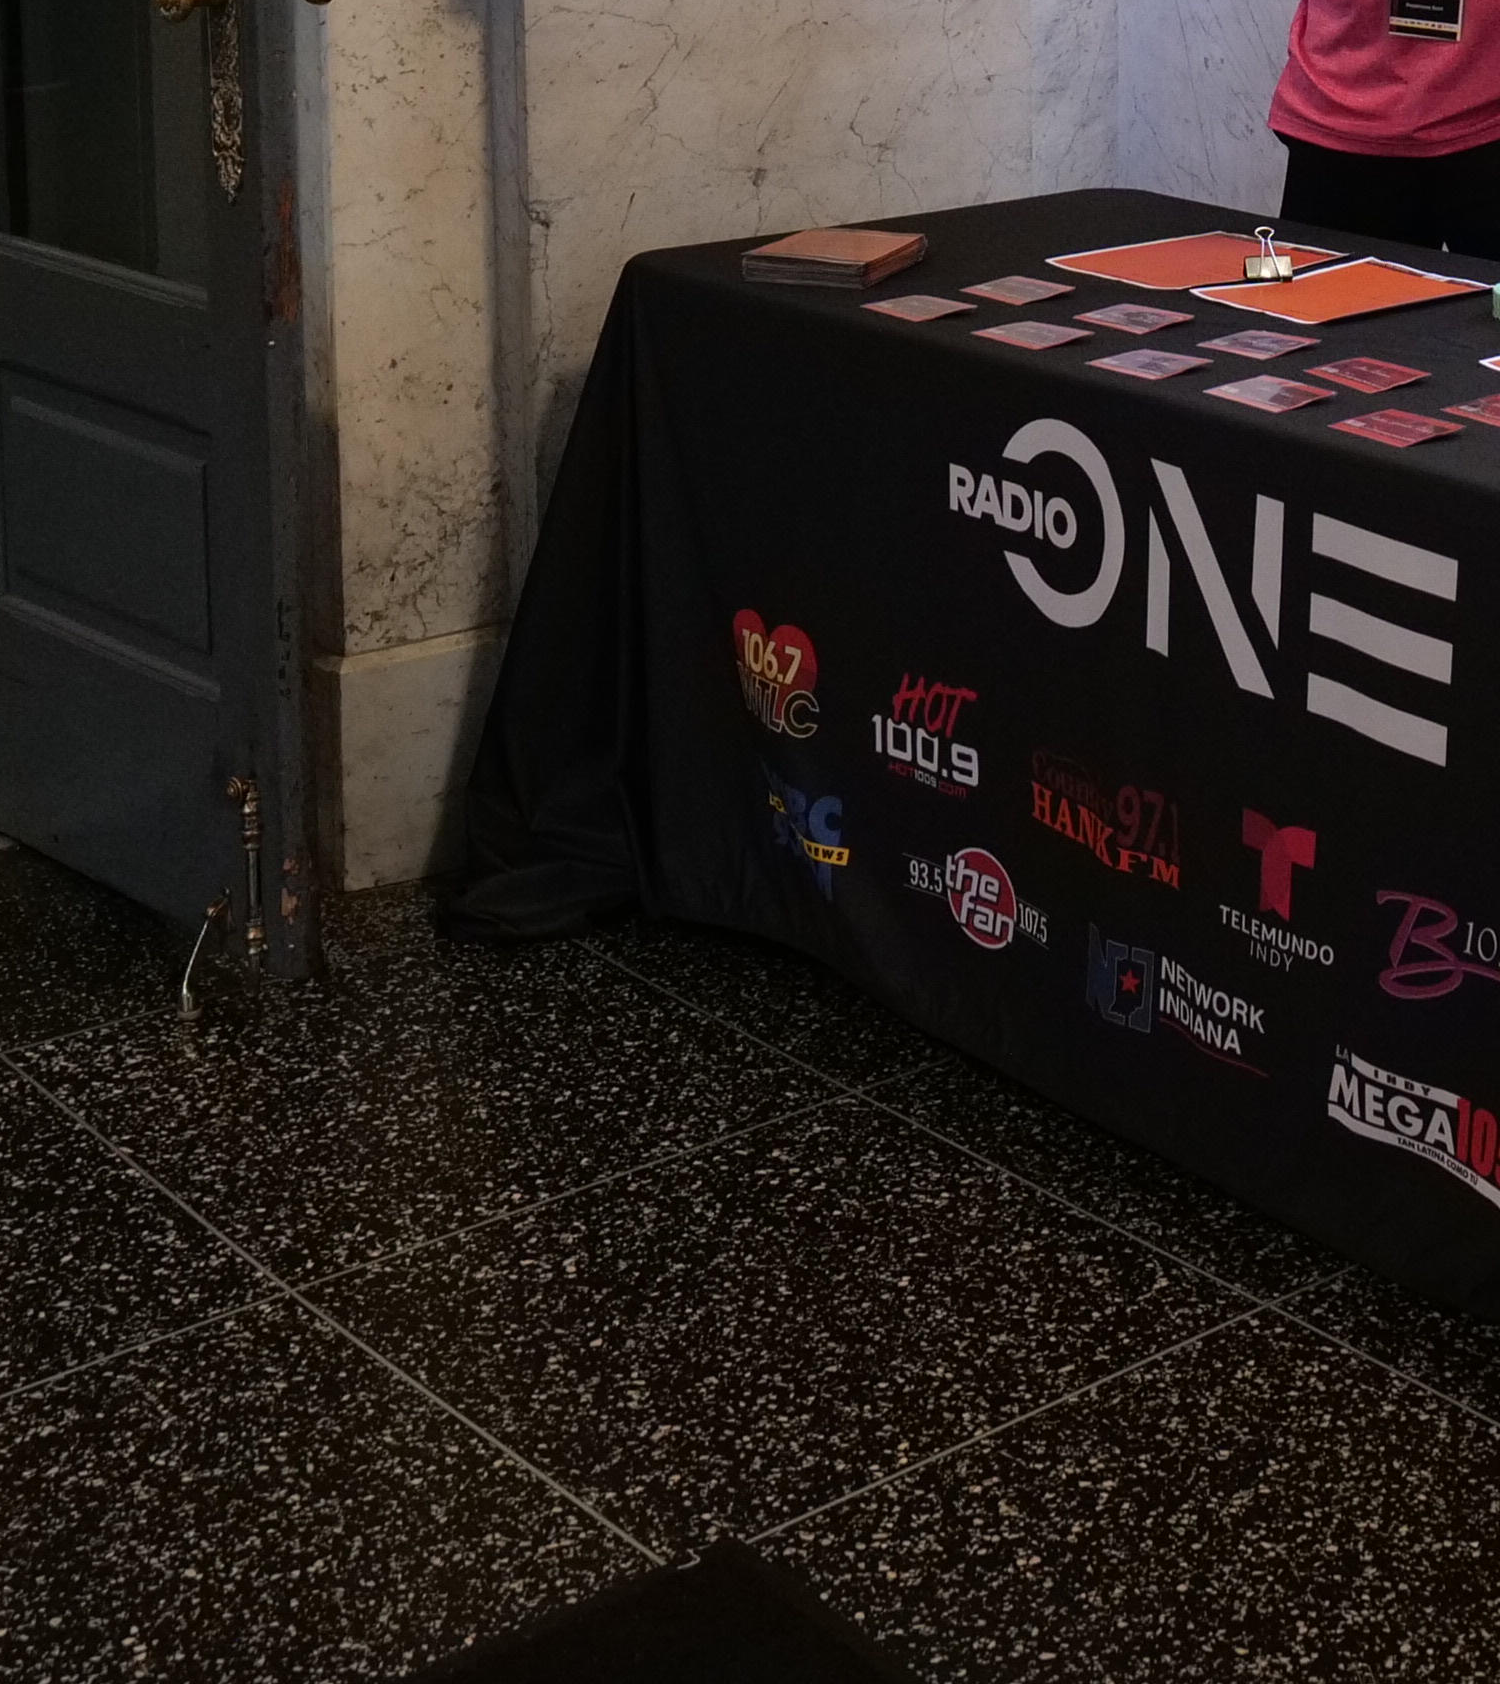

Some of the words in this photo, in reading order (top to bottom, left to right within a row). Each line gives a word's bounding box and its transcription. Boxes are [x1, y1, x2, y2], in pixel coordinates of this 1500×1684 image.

[949, 462, 1078, 550] RADIO
[1001, 417, 1458, 767] ONE
[742, 628, 802, 685] 106.7
[736, 661, 820, 738] WTLC
[893, 673, 979, 738] HOT
[871, 714, 980, 787] 100.9
[1031, 780, 1114, 867] HANK
[1116, 847, 1181, 890] FM
[909, 859, 943, 893] 93.5
[945, 855, 999, 898] the
[960, 892, 1015, 943] fan
[1018, 903, 1048, 944] 107.5
[1219, 904, 1334, 966] TELEMUNDO
[1249, 941, 1294, 972] INDY
[1160, 988, 1242, 1055] INDIANA
[1161, 956, 1265, 1034] NETWORK
[1335, 1044, 1350, 1063] LA
[1373, 1069, 1431, 1096] INDY
[1328, 1063, 1455, 1156] MEGA
[1416, 1142, 1445, 1164] LATINA
[1446, 1158, 1469, 1180] COMO
